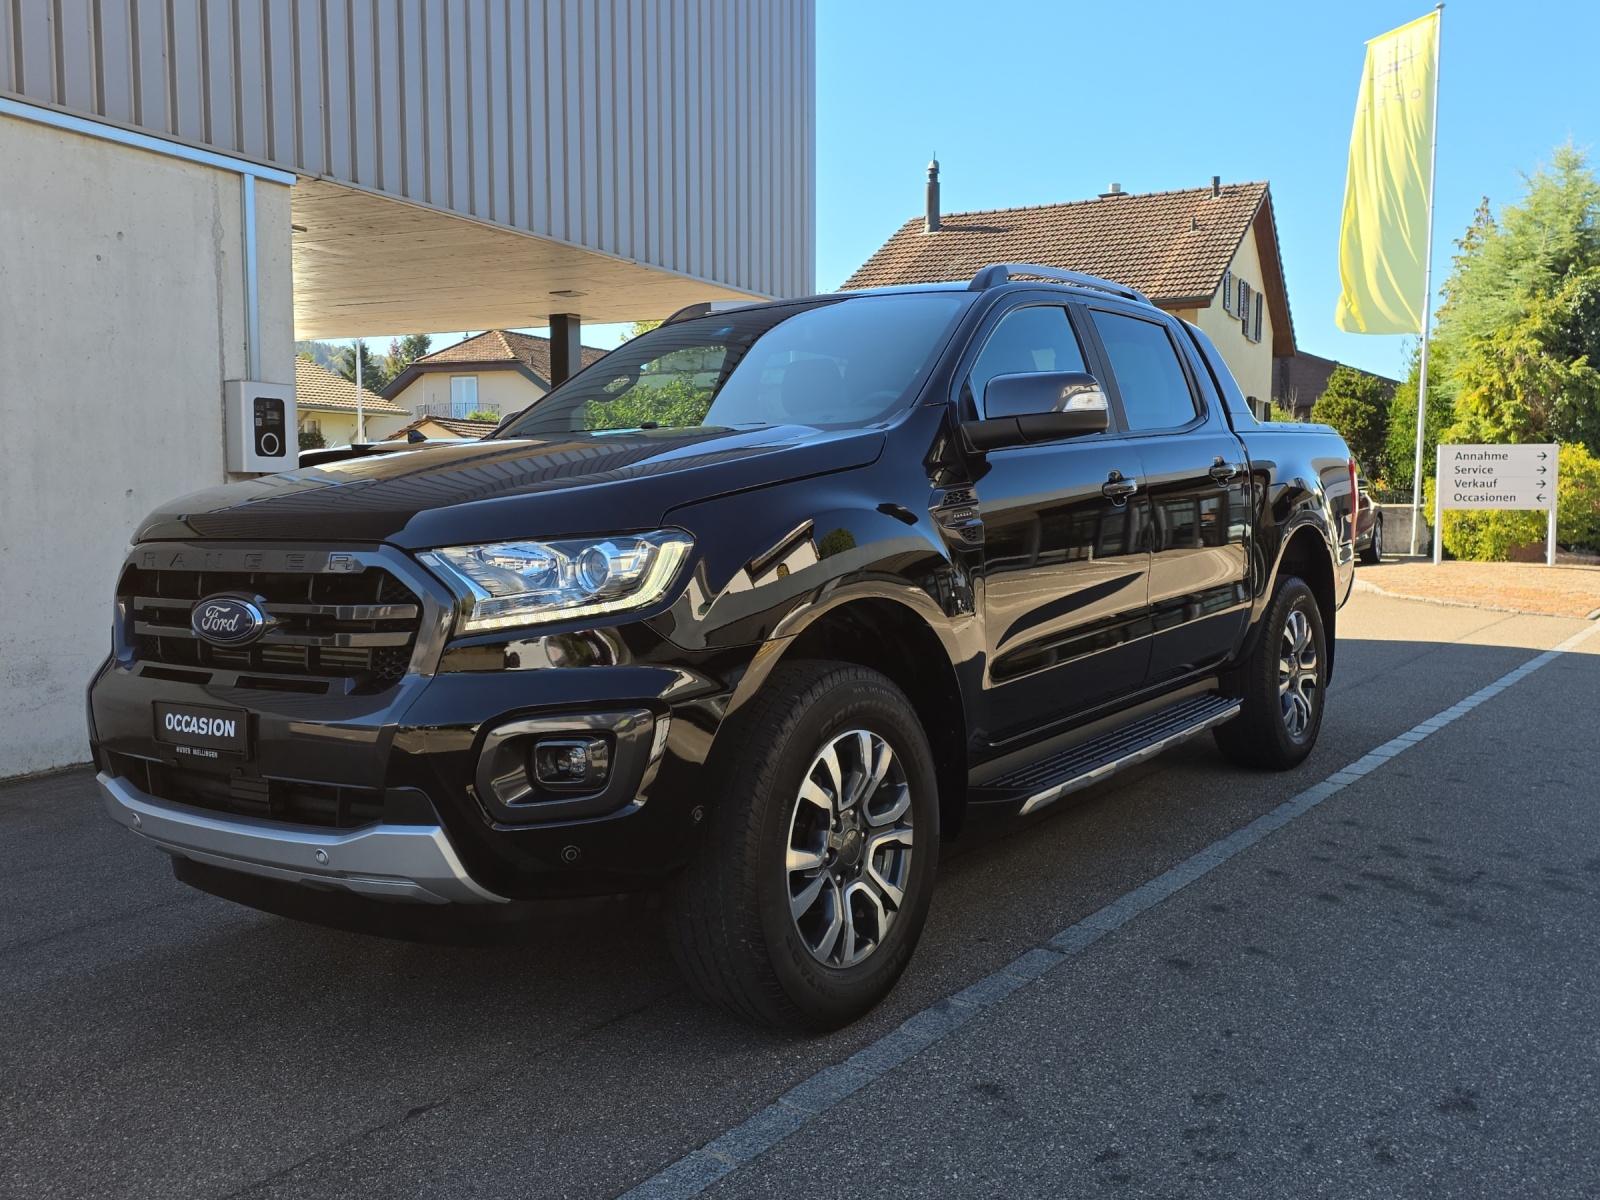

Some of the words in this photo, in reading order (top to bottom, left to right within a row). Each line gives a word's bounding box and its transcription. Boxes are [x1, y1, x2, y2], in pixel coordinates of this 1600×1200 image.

[1454, 451, 1509, 461] Annahme
[1454, 465, 1494, 474] Service
[1454, 479, 1498, 489] Verkauf
[1453, 493, 1516, 502] Occasionen
[142, 552, 353, 570] RANGER
[201, 605, 239, 632] Ford
[165, 713, 235, 737] OCCASION
